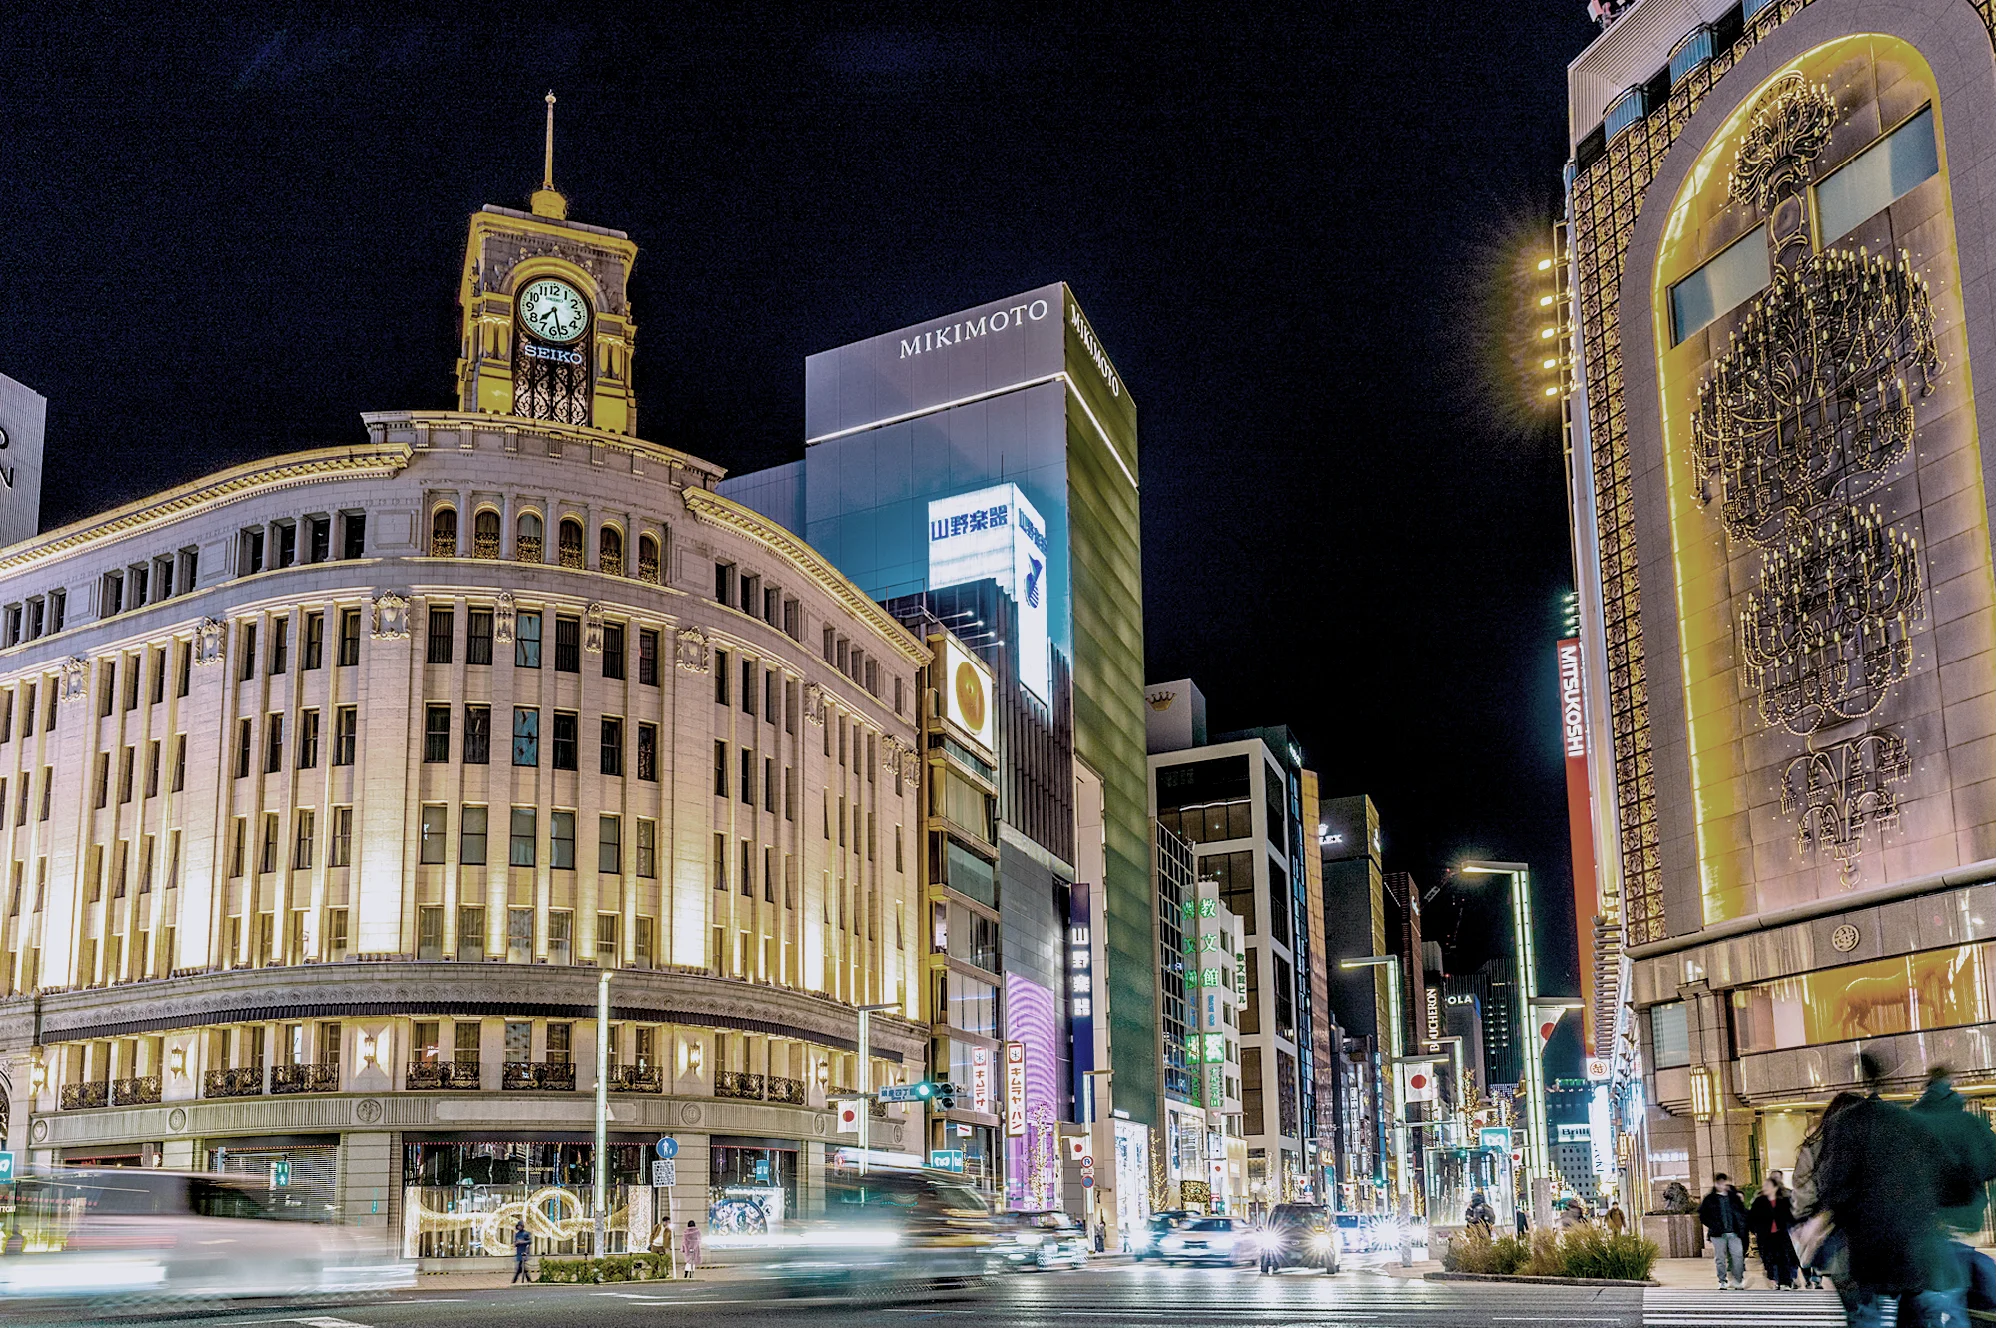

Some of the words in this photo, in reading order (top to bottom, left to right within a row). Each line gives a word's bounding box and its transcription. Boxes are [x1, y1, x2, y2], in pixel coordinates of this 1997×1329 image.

[539, 286, 547, 296] 11
[550, 286, 560, 296] 12
[564, 291, 567, 300] 1
[530, 292, 539, 302] 10
[526, 302, 534, 311] 9
[571, 299, 578, 309] 2
[529, 312, 538, 323] 8
[574, 310, 582, 320] 3
[539, 322, 547, 331] 7
[561, 325, 568, 335] 5
[569, 321, 578, 330] 4
[899, 299, 1048, 359] MIKIMOTO
[549, 326, 557, 336] 6
[525, 344, 582, 364] SEIKO
[1071, 303, 1119, 397] MIKIMOTO
[931, 504, 1008, 542] 山野楽器
[1561, 645, 1584, 757] MITSUKOSHI
[1199, 898, 1219, 987] 教文館
[1445, 995, 1473, 1005] OLA
[1426, 988, 1440, 1052] BUCHERON
